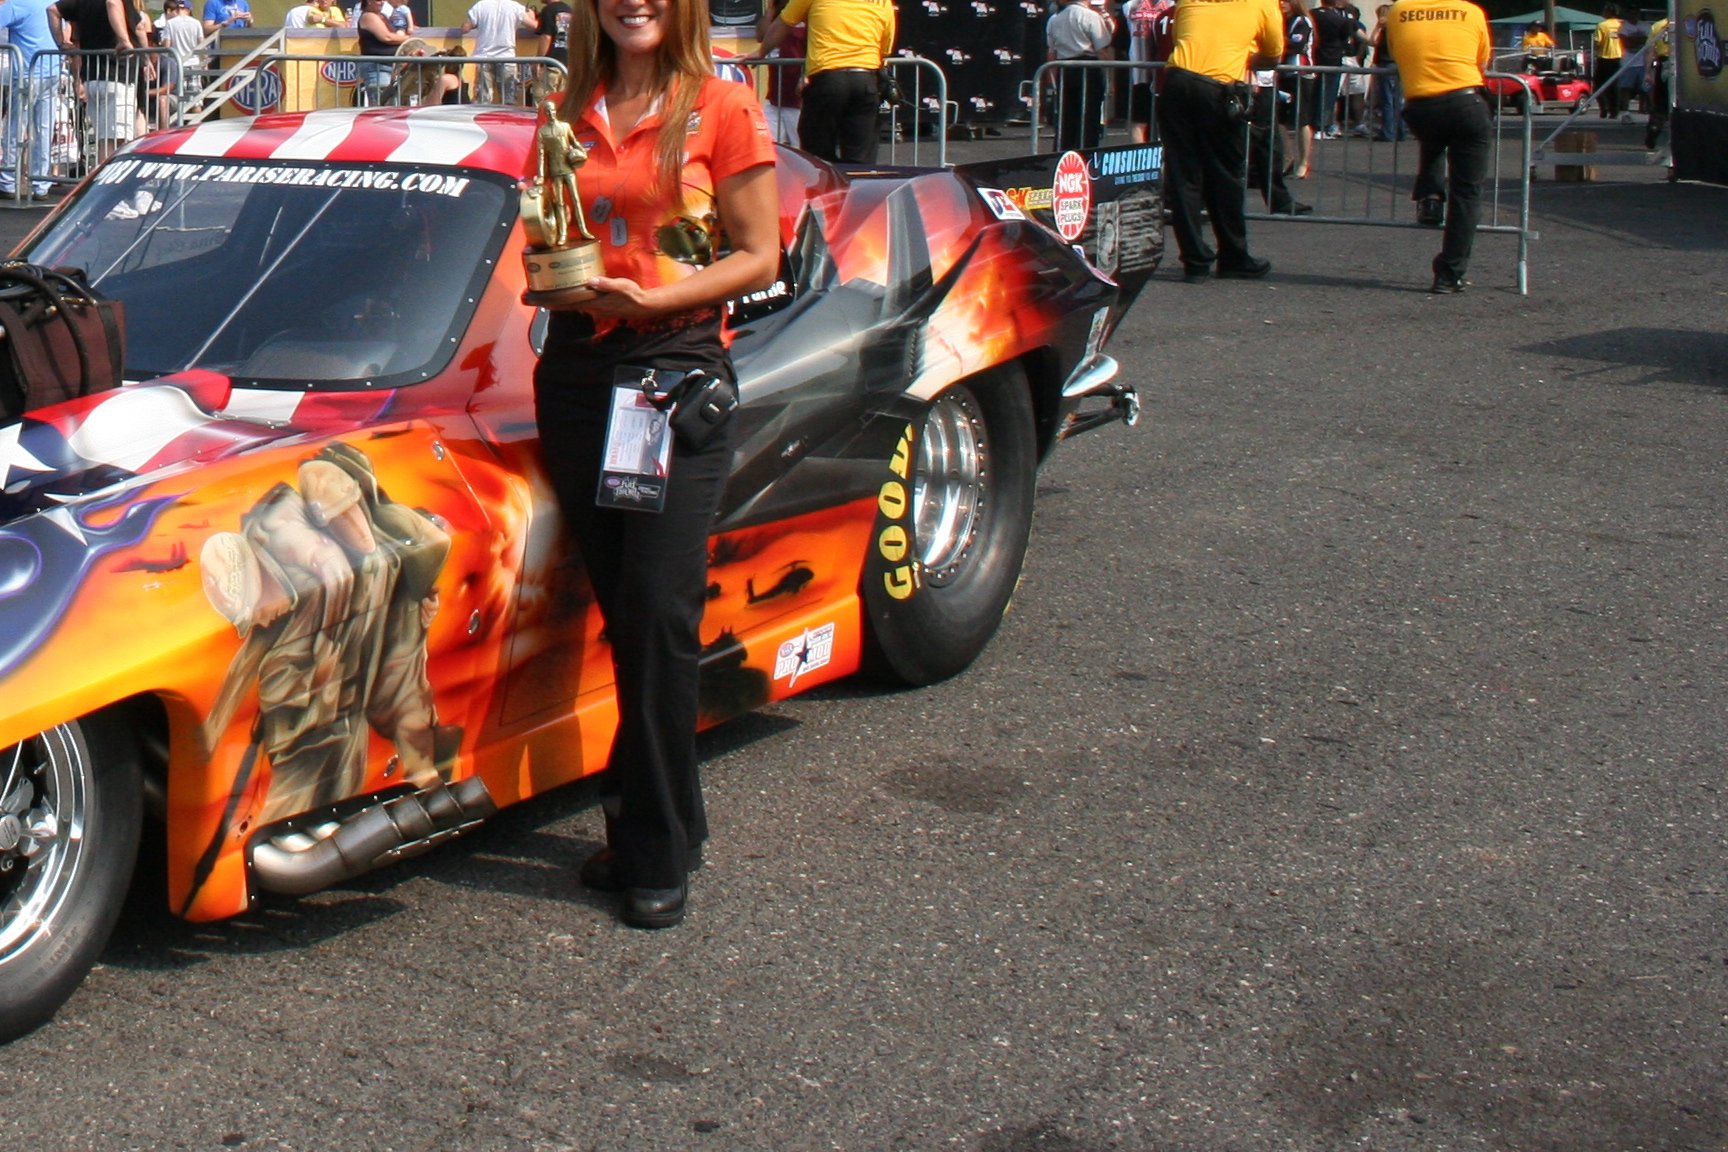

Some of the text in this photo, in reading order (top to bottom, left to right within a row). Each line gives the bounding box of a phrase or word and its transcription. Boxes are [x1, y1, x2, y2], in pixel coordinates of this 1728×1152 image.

[1399, 8, 1467, 23] SECURITY
[329, 63, 357, 83] NHR
[136, 161, 470, 198] WWW.PARISERACING.COM
[1059, 173, 1083, 194] NGK
[1060, 201, 1082, 211] SPARK
[1060, 212, 1083, 223] PLUGS
